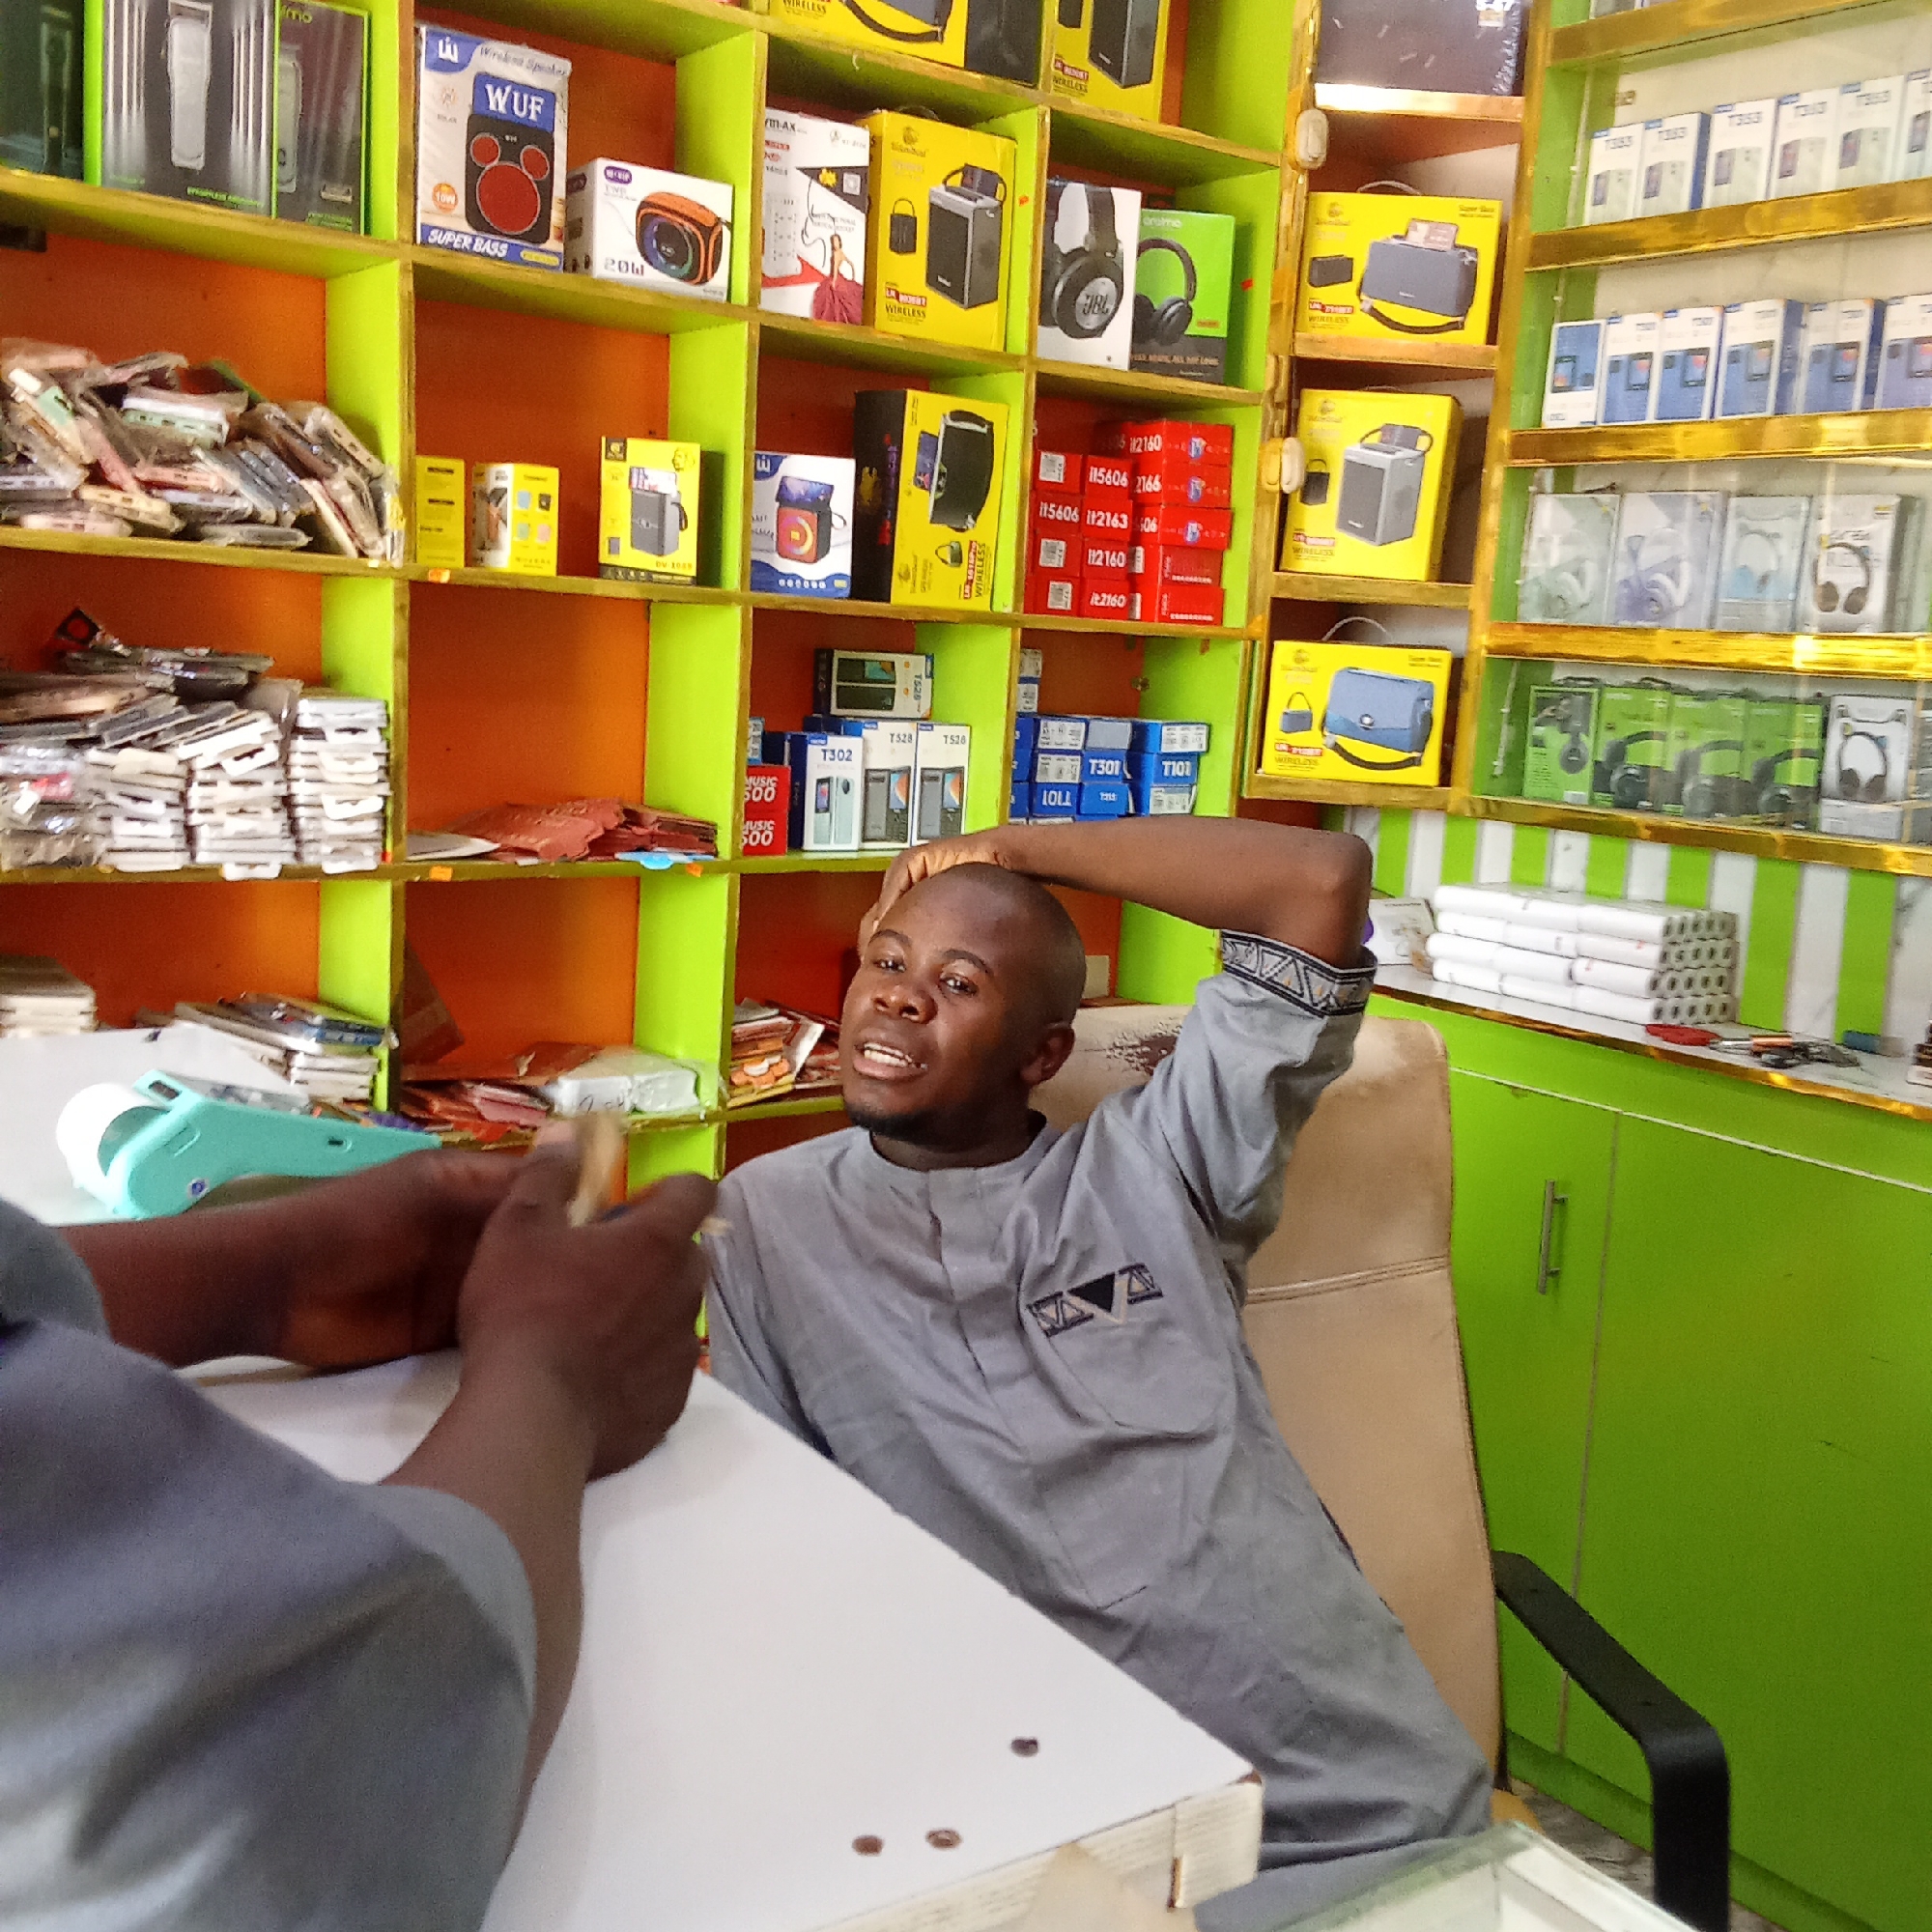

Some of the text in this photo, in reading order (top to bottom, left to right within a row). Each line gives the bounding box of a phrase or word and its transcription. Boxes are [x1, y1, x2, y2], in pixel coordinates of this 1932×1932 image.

[485, 83, 545, 123] WUF
[428, 228, 472, 251] SUPER
[470, 236, 509, 258] BASS
[885, 304, 926, 319] WIRELESS
[1082, 294, 1110, 316] JBL
[975, 542, 985, 598] WIRELESS
[821, 749, 854, 762] T302
[1162, 760, 1192, 778] T101
[746, 776, 779, 788] MUSIC
[744, 820, 776, 832] MUSIC
